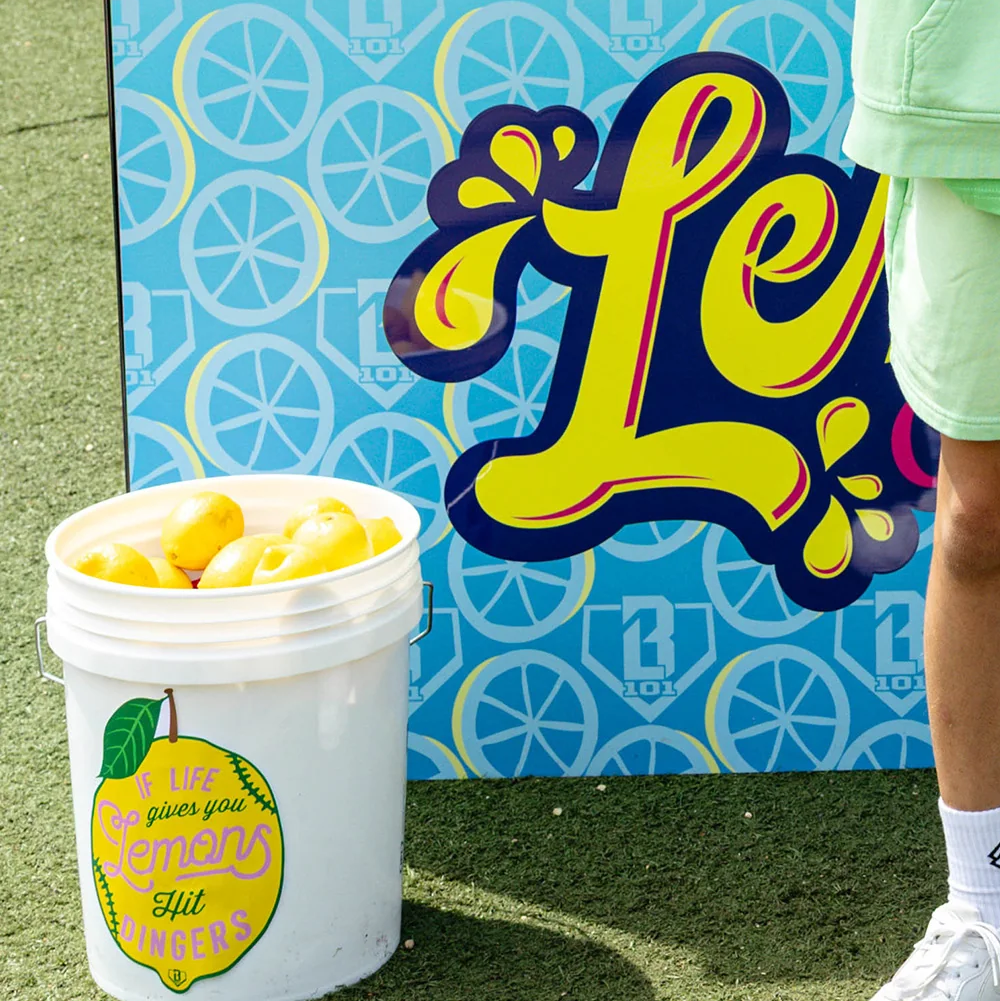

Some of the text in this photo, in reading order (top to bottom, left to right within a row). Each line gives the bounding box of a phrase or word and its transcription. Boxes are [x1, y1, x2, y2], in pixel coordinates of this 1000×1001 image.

[347, 38, 406, 56] 101
[608, 35, 665, 53] 101
[622, 679, 677, 696] 101
[134, 766, 221, 800] IF LIFE
[146, 797, 248, 828] gives you
[97, 799, 273, 893] Lemons
[152, 888, 207, 922] Hit
[120, 909, 253, 961] DINGERS
